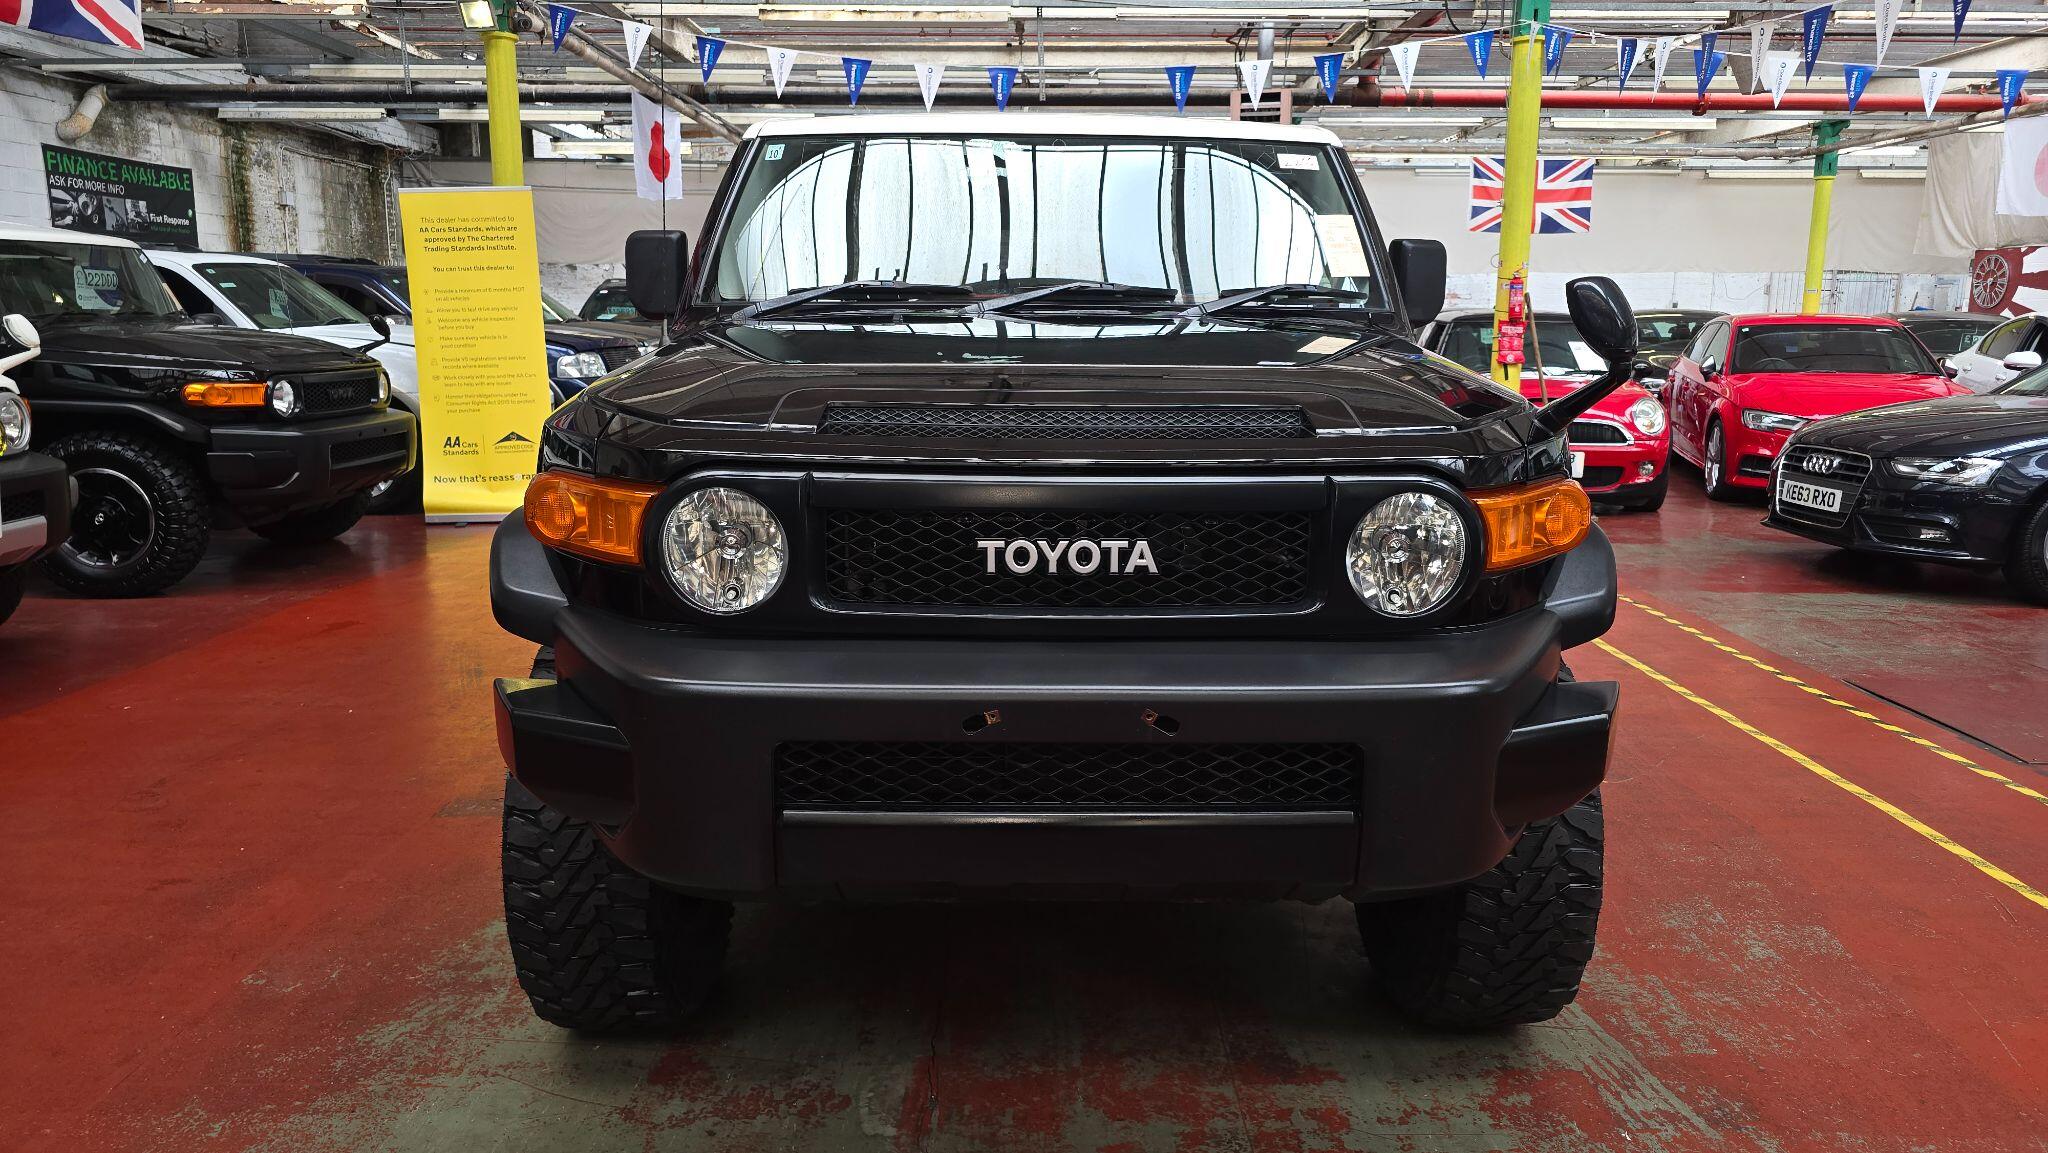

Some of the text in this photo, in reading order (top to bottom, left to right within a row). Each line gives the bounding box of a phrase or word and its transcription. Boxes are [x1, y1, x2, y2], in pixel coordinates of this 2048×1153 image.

[1549, 33, 1558, 52] Finance
[1808, 20, 1817, 50] Finance
[1880, 23, 1888, 54] Brothers
[1850, 72, 1858, 92] Finance
[769, 150, 778, 159] 10
[46, 151, 192, 192] FINANCE AVAILABLE
[50, 174, 125, 195] ASK FOR MORE INFO
[163, 214, 190, 226] Response
[444, 436, 461, 448] AA
[433, 474, 535, 483] Now that's reassra
[1785, 484, 1836, 508] KE63 RXO
[977, 539, 1159, 575] TOYOTA
